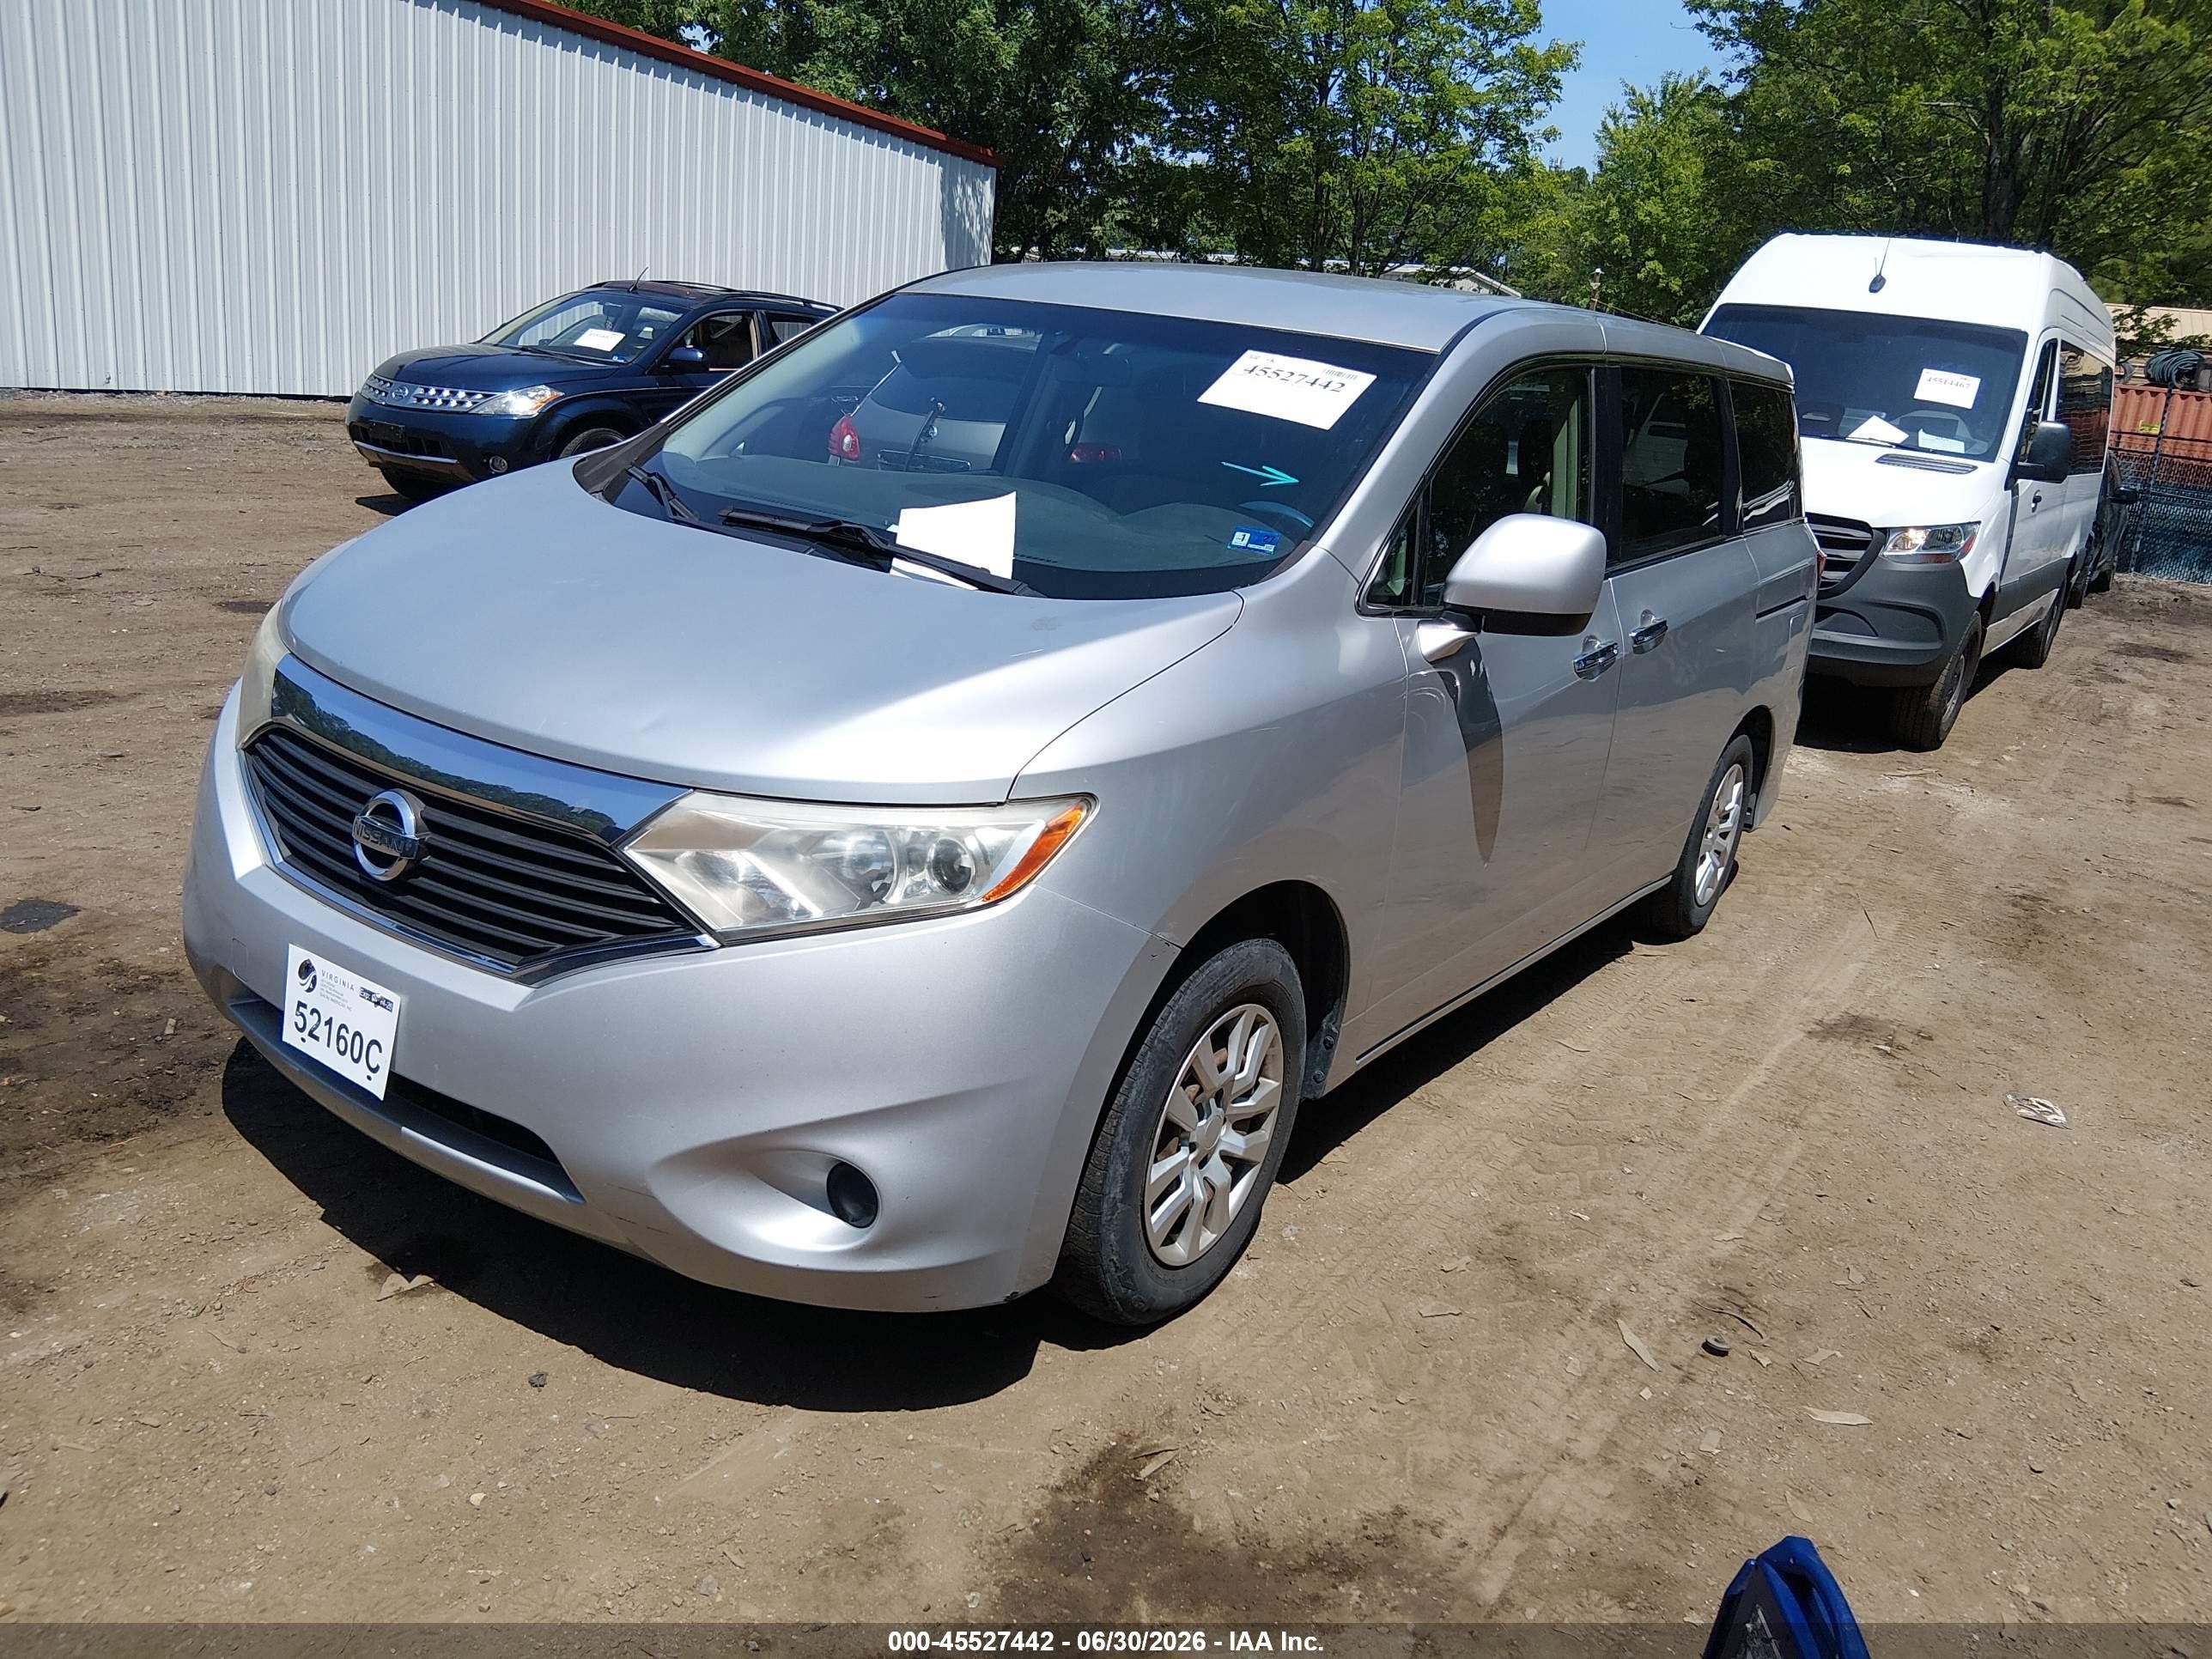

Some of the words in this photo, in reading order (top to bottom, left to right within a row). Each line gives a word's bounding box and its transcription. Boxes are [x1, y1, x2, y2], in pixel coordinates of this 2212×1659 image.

[1243, 365, 1346, 392] 45527442
[355, 823, 403, 854] NISSAN
[320, 969, 355, 991] VIRGINIA
[294, 1000, 383, 1074] 52160C
